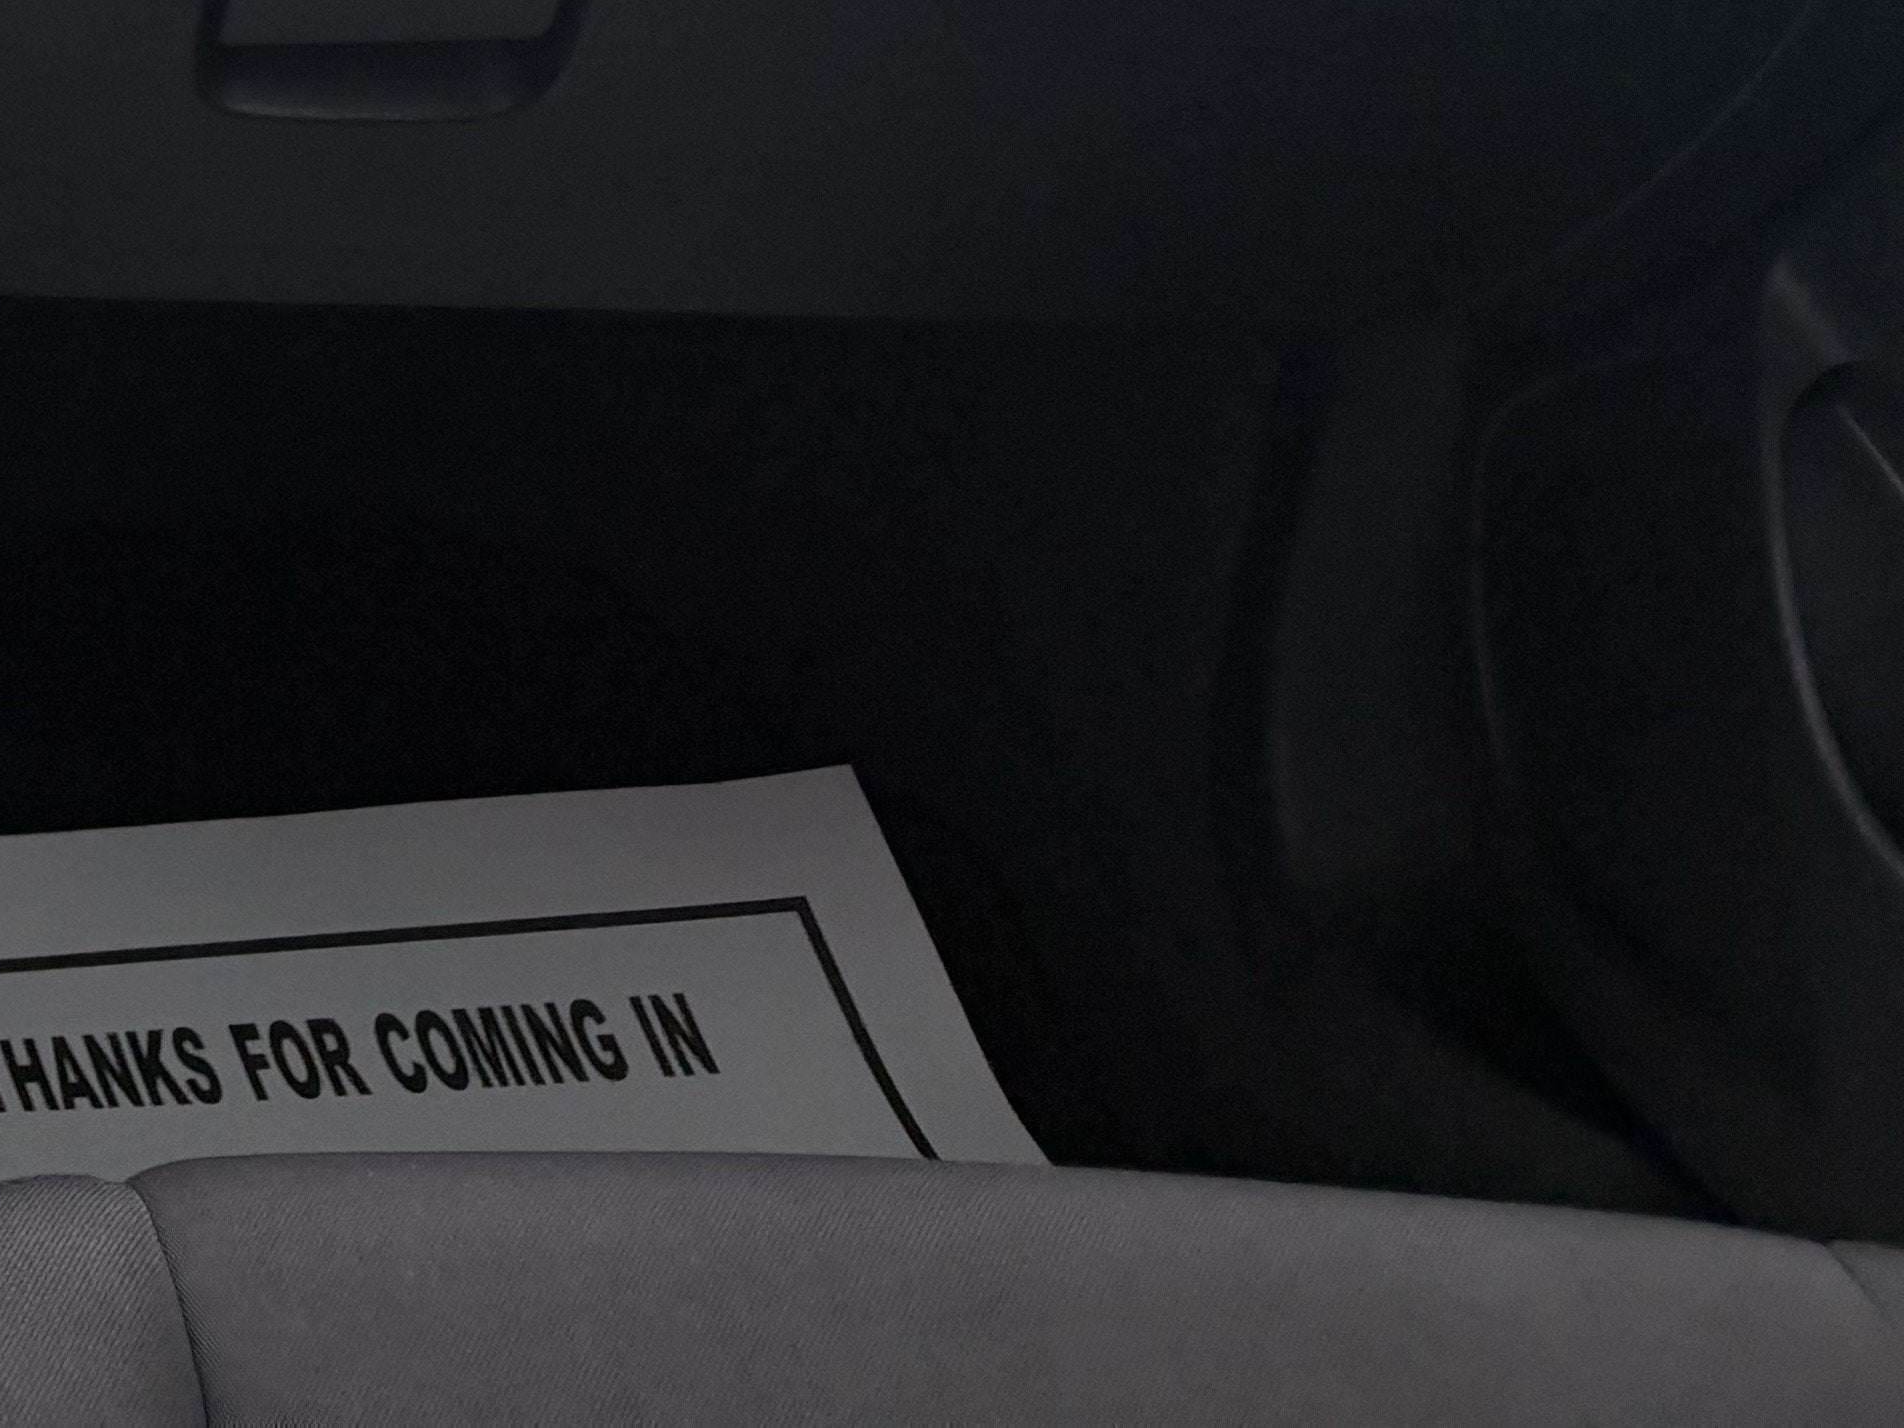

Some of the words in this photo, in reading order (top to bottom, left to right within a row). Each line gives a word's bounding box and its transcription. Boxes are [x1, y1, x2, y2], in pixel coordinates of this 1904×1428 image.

[229, 1015, 372, 1104] FOR
[373, 997, 625, 1094] COMING
[629, 991, 720, 1078] IN
